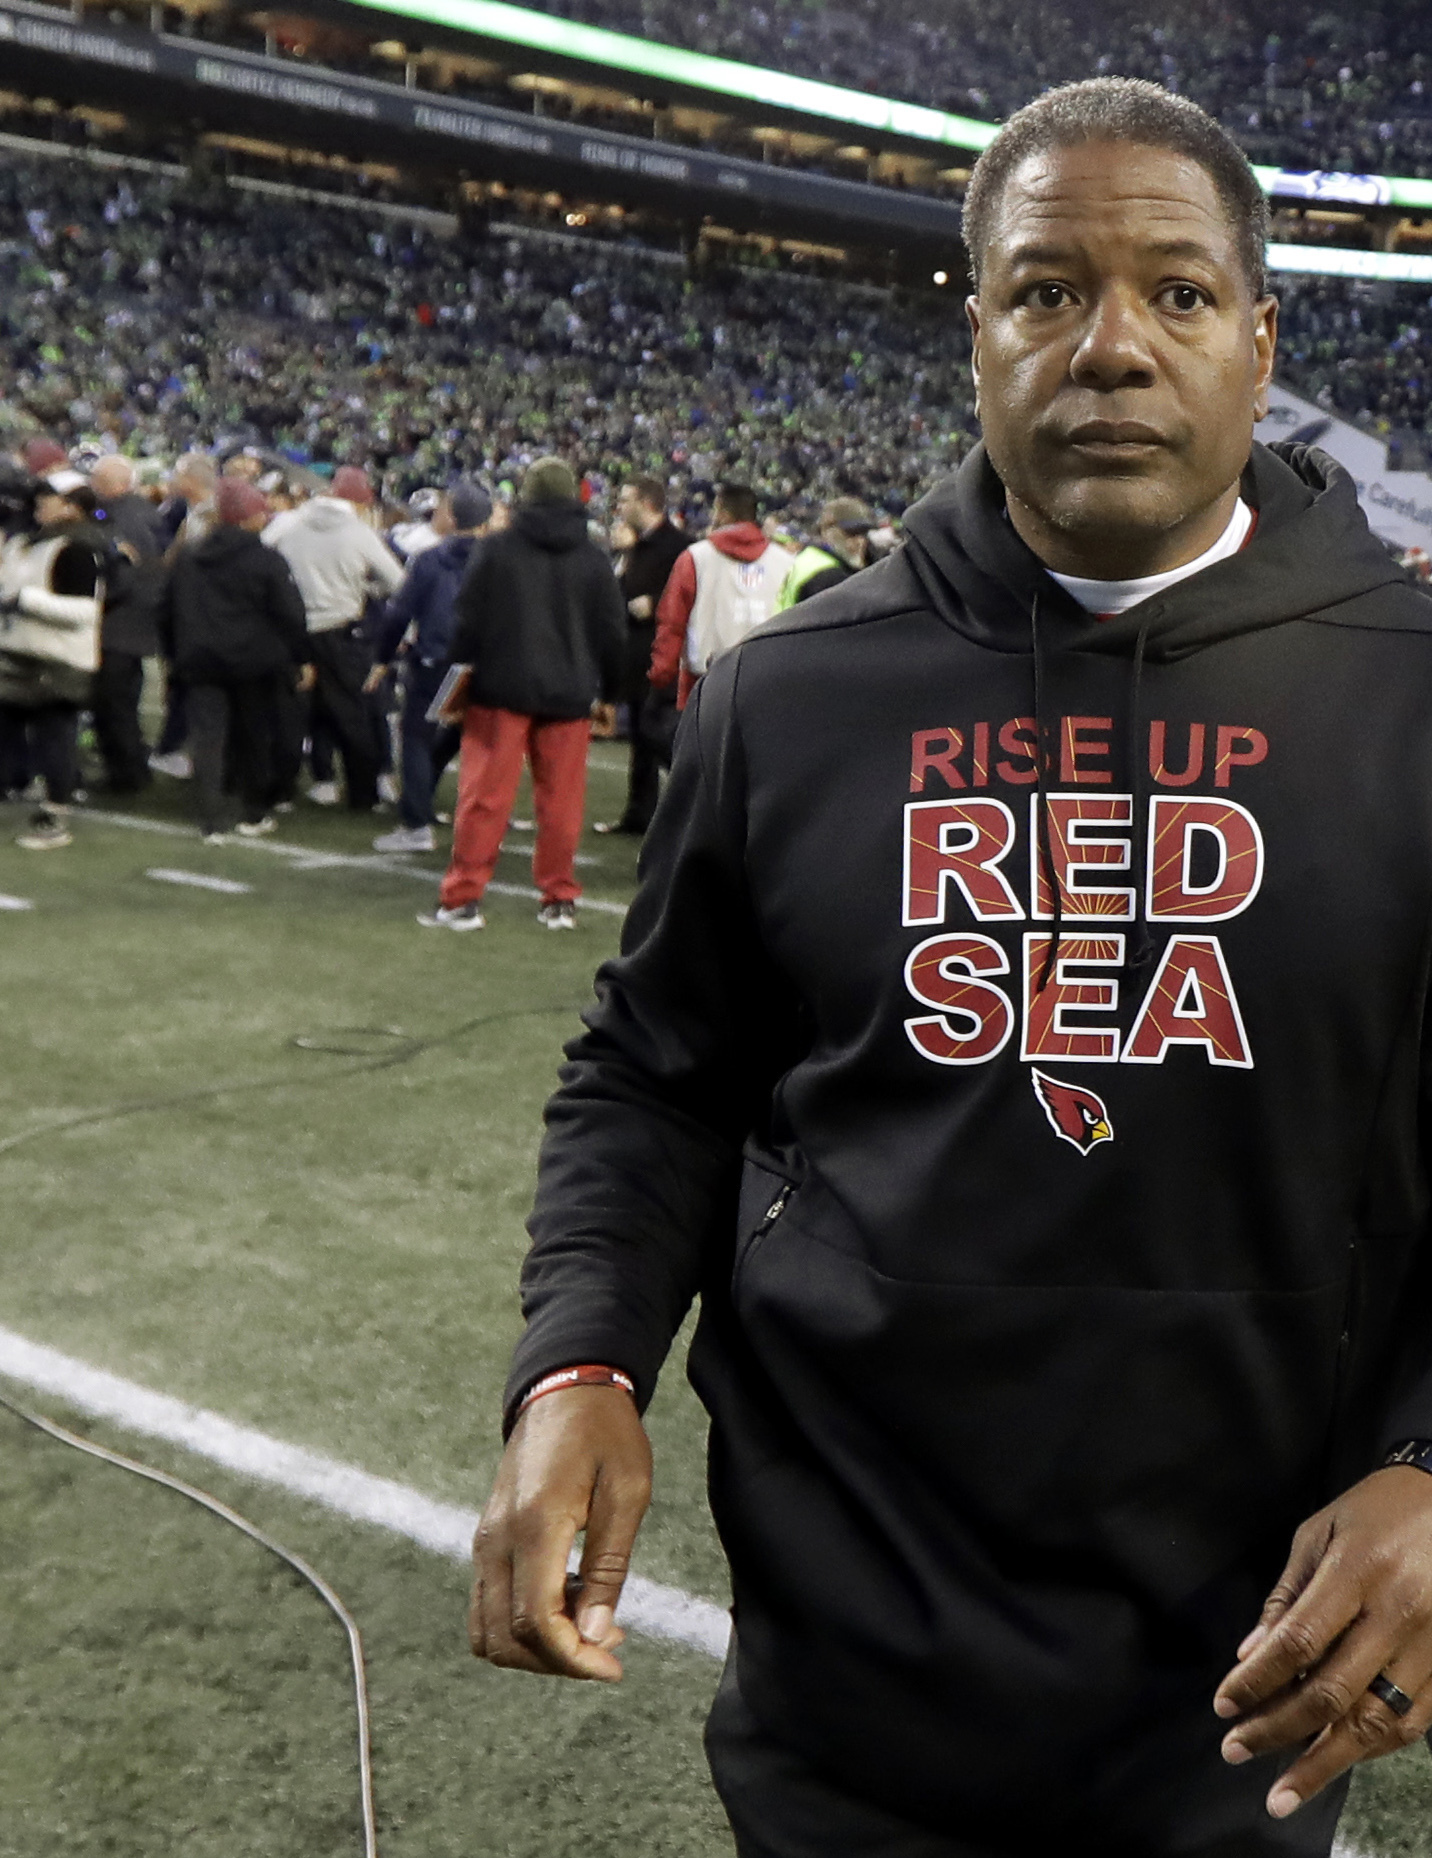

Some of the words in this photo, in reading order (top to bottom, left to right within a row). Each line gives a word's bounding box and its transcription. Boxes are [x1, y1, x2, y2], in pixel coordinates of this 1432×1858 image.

[908, 715, 1114, 793] RISE
[1148, 718, 1270, 788] UP
[901, 792, 1265, 927] RED
[903, 932, 1255, 1069] SEA
